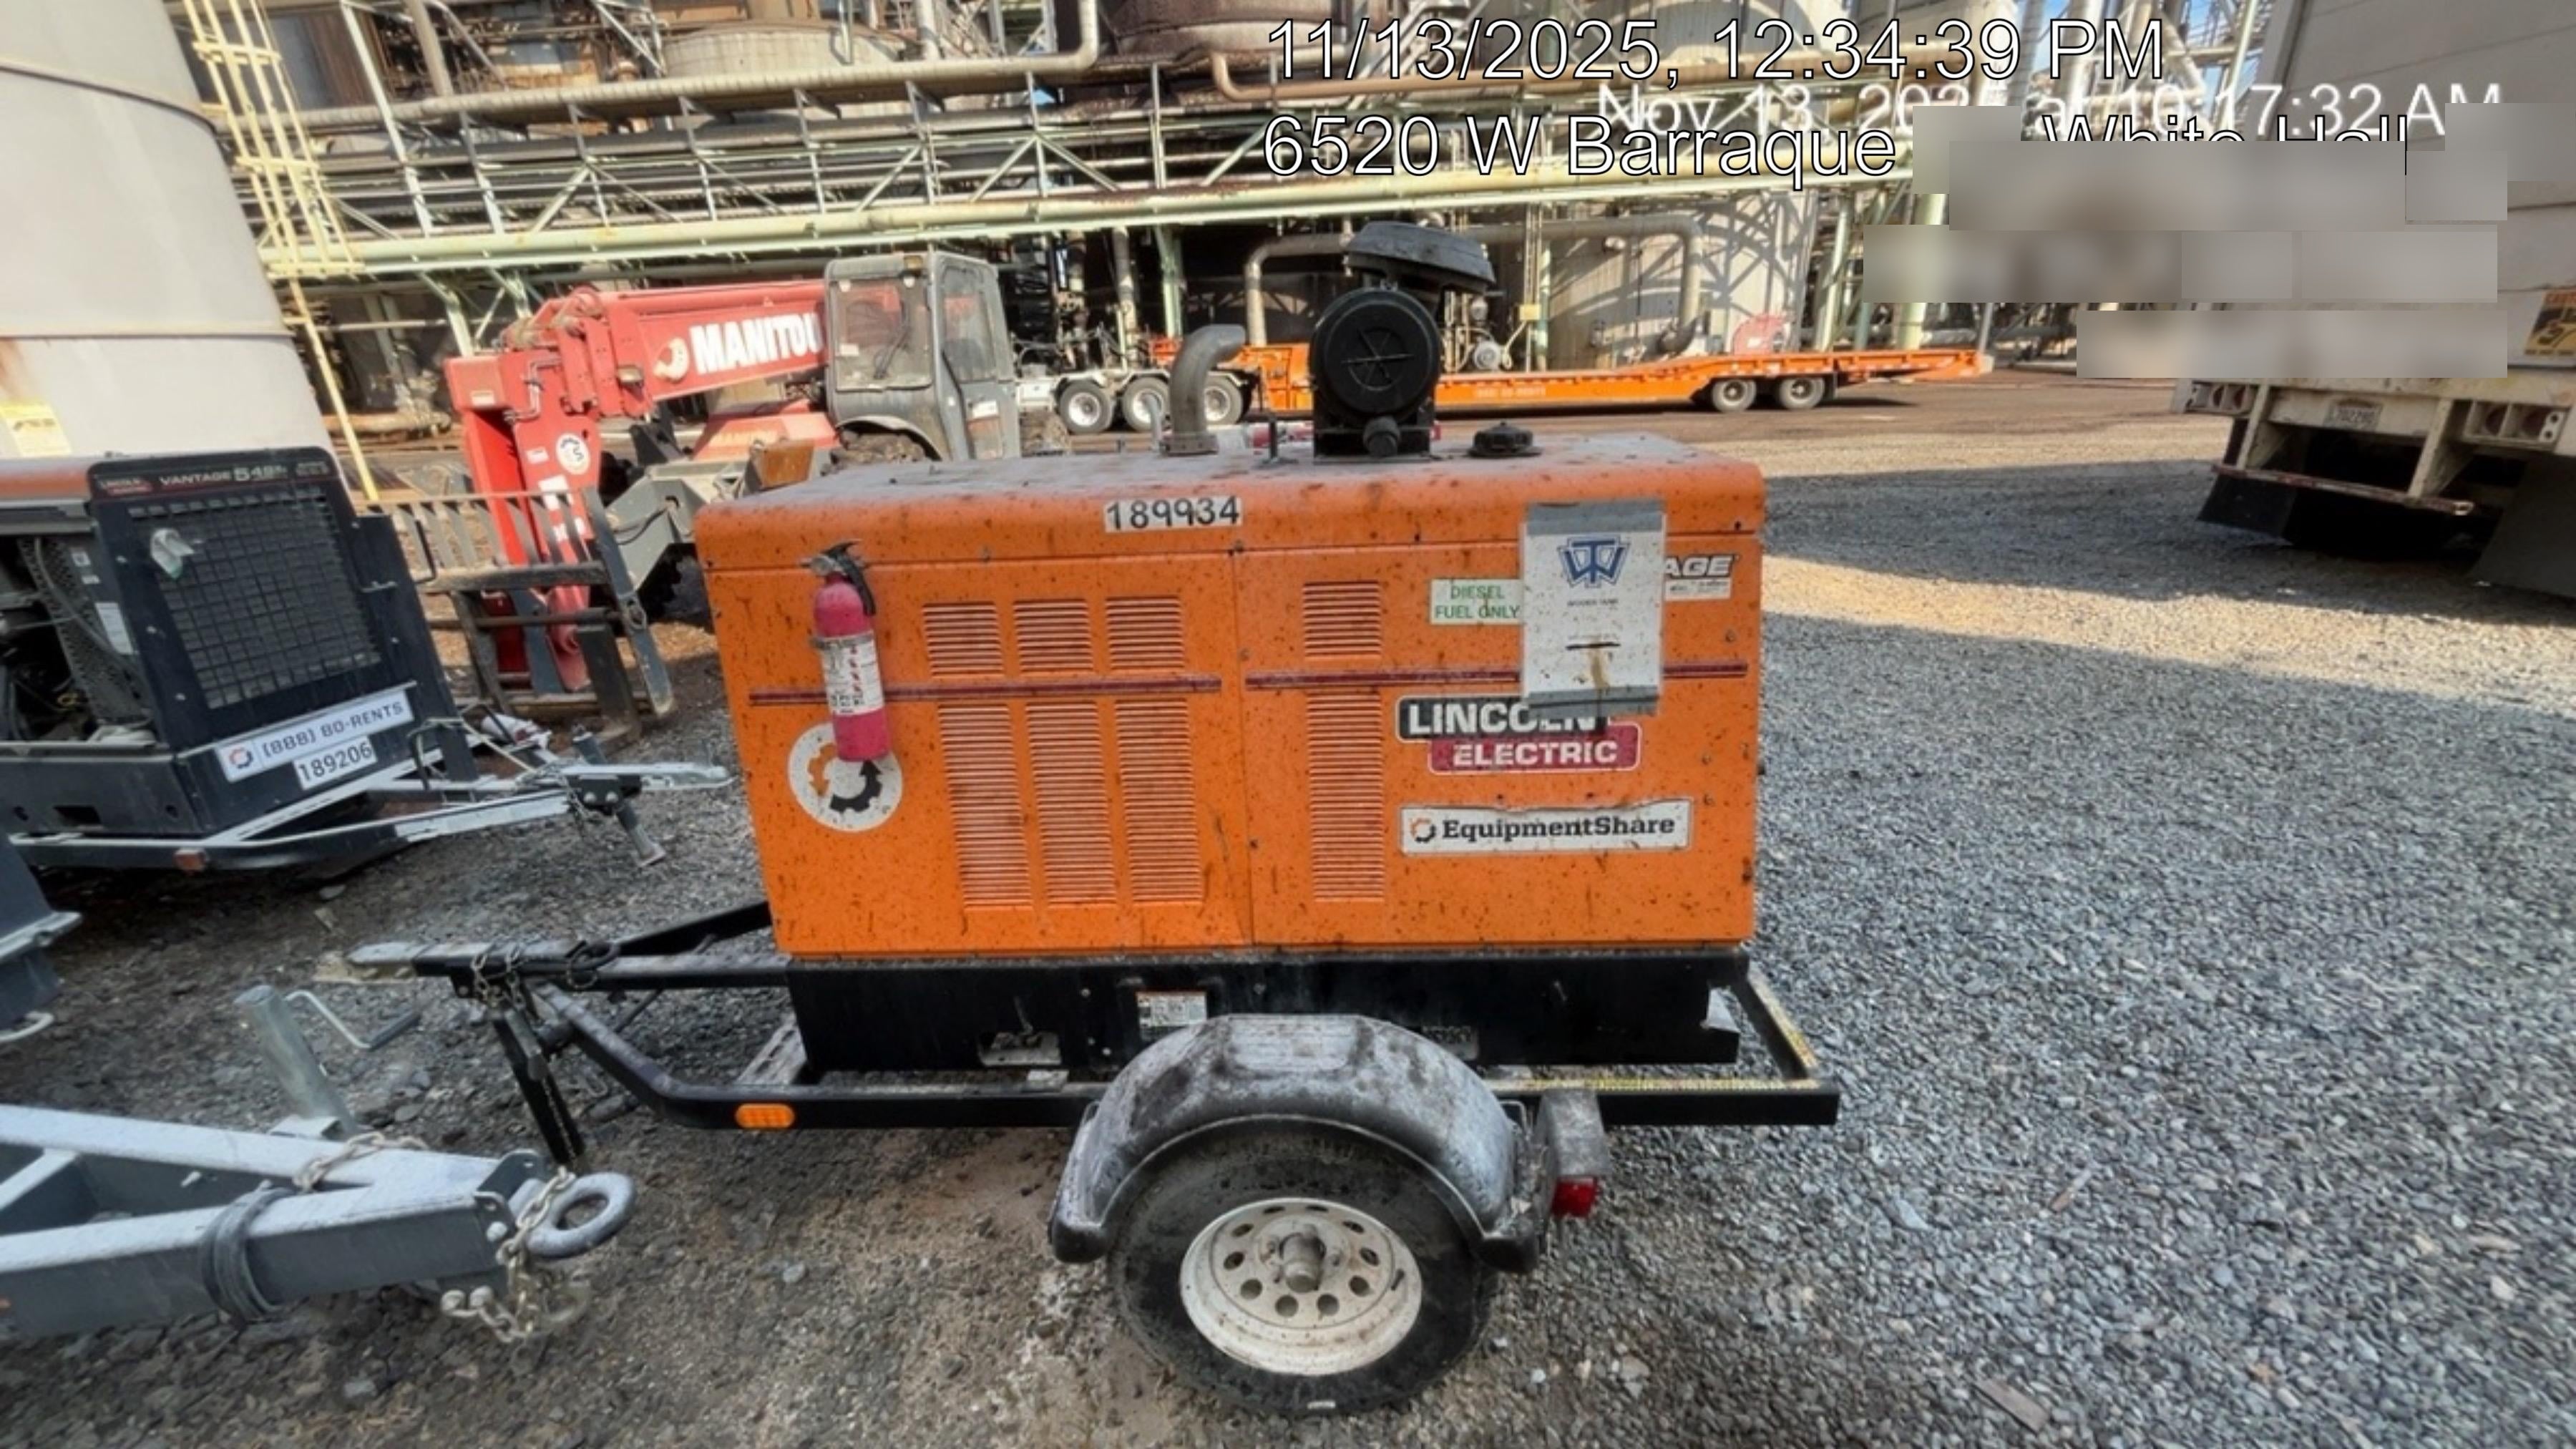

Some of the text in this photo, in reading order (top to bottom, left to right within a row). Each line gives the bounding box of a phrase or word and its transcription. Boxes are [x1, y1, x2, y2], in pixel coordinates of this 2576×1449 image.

[159, 471, 231, 486] VANTAGE
[1106, 495, 1240, 529] 189934
[1449, 585, 1505, 600] DIESEL
[1435, 605, 1520, 620] FUEL ONLY
[263, 728, 317, 758] (888)
[1453, 740, 1618, 766] ELECTRIC
[297, 741, 374, 782] 189206
[1442, 814, 1676, 843] EquipmentShare
